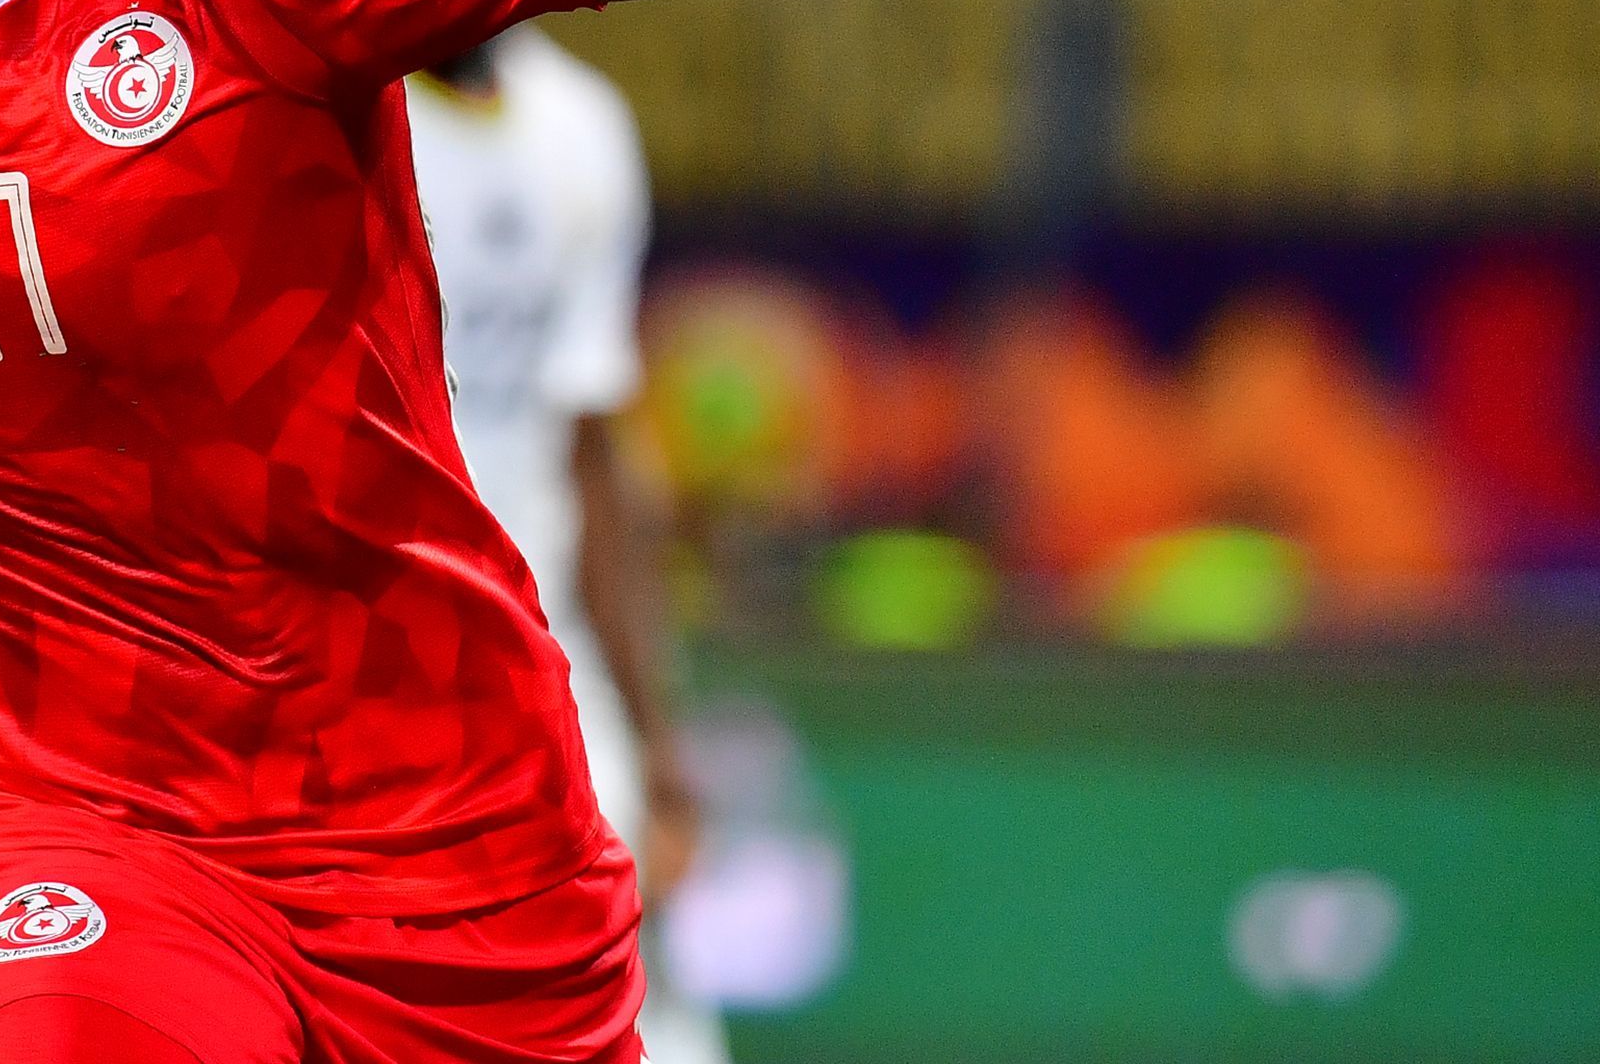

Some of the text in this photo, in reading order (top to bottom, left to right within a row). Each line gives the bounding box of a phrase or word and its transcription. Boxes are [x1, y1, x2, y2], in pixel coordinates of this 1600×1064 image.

[72, 62, 189, 141] FEDERATION TUNISIENNE DE FOOTBALL
